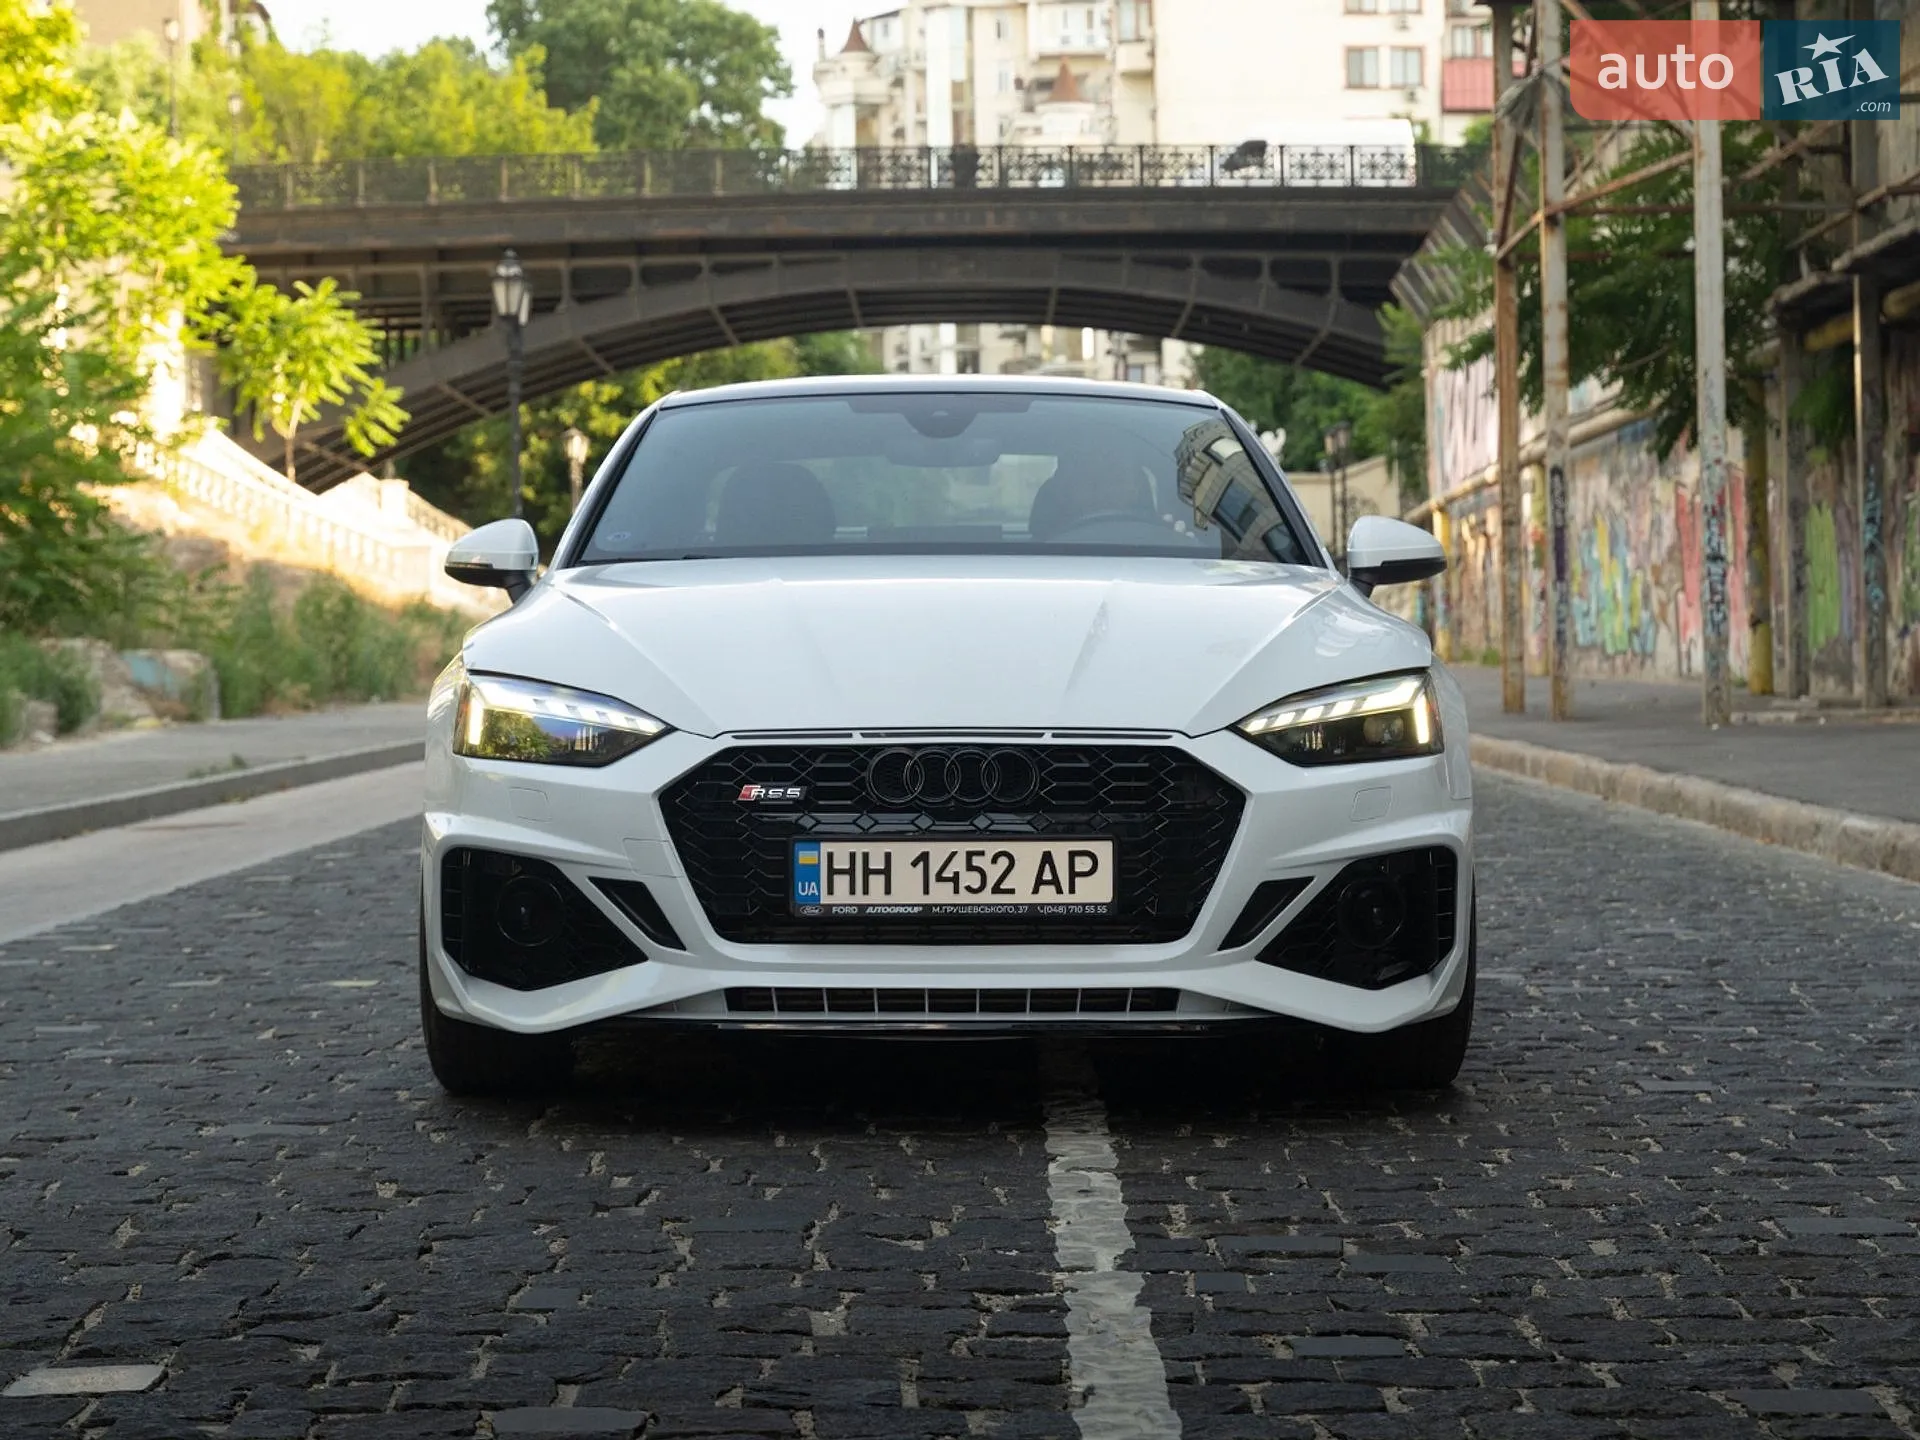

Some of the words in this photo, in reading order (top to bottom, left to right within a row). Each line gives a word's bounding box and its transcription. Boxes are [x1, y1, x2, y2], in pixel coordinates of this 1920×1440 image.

[826, 851, 892, 896] HH
[910, 850, 1016, 895] 1452
[1031, 850, 1099, 895] AP
[798, 882, 819, 896] UA
[831, 906, 858, 914] FORD
[866, 906, 923, 914] AUTOGROUP
[1068, 905, 1083, 914] 710
[1085, 905, 1095, 914] 55
[1097, 905, 1108, 914] 55
